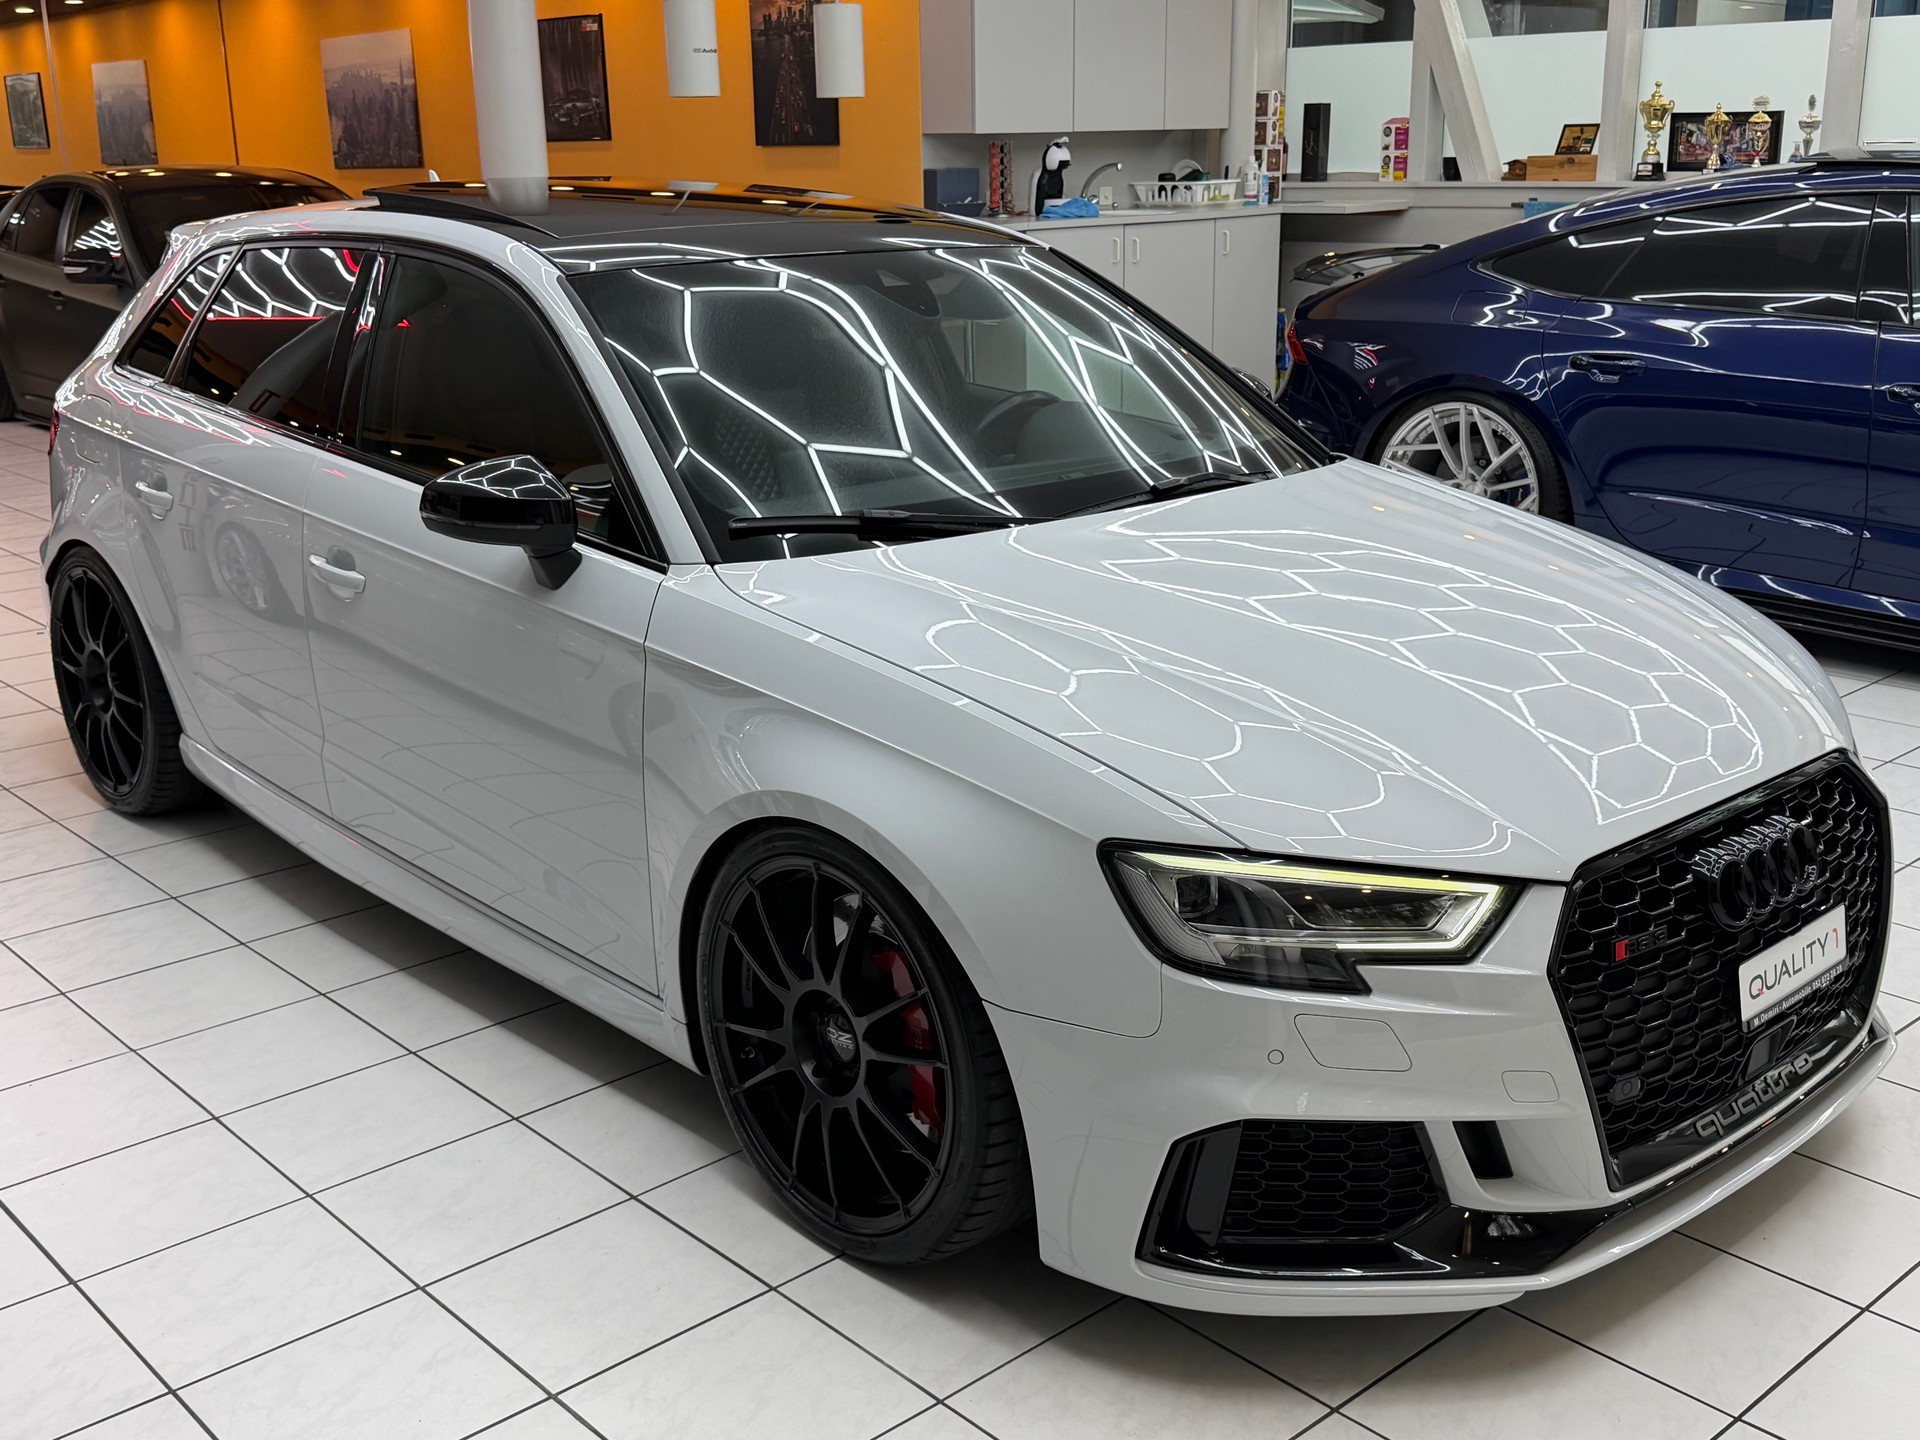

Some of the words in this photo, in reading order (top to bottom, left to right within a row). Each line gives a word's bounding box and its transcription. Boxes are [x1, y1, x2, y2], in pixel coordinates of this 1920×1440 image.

[1749, 932, 1829, 1000] QUALITY
[1832, 927, 1839, 949] 1
[1695, 1053, 1813, 1138] quattro
